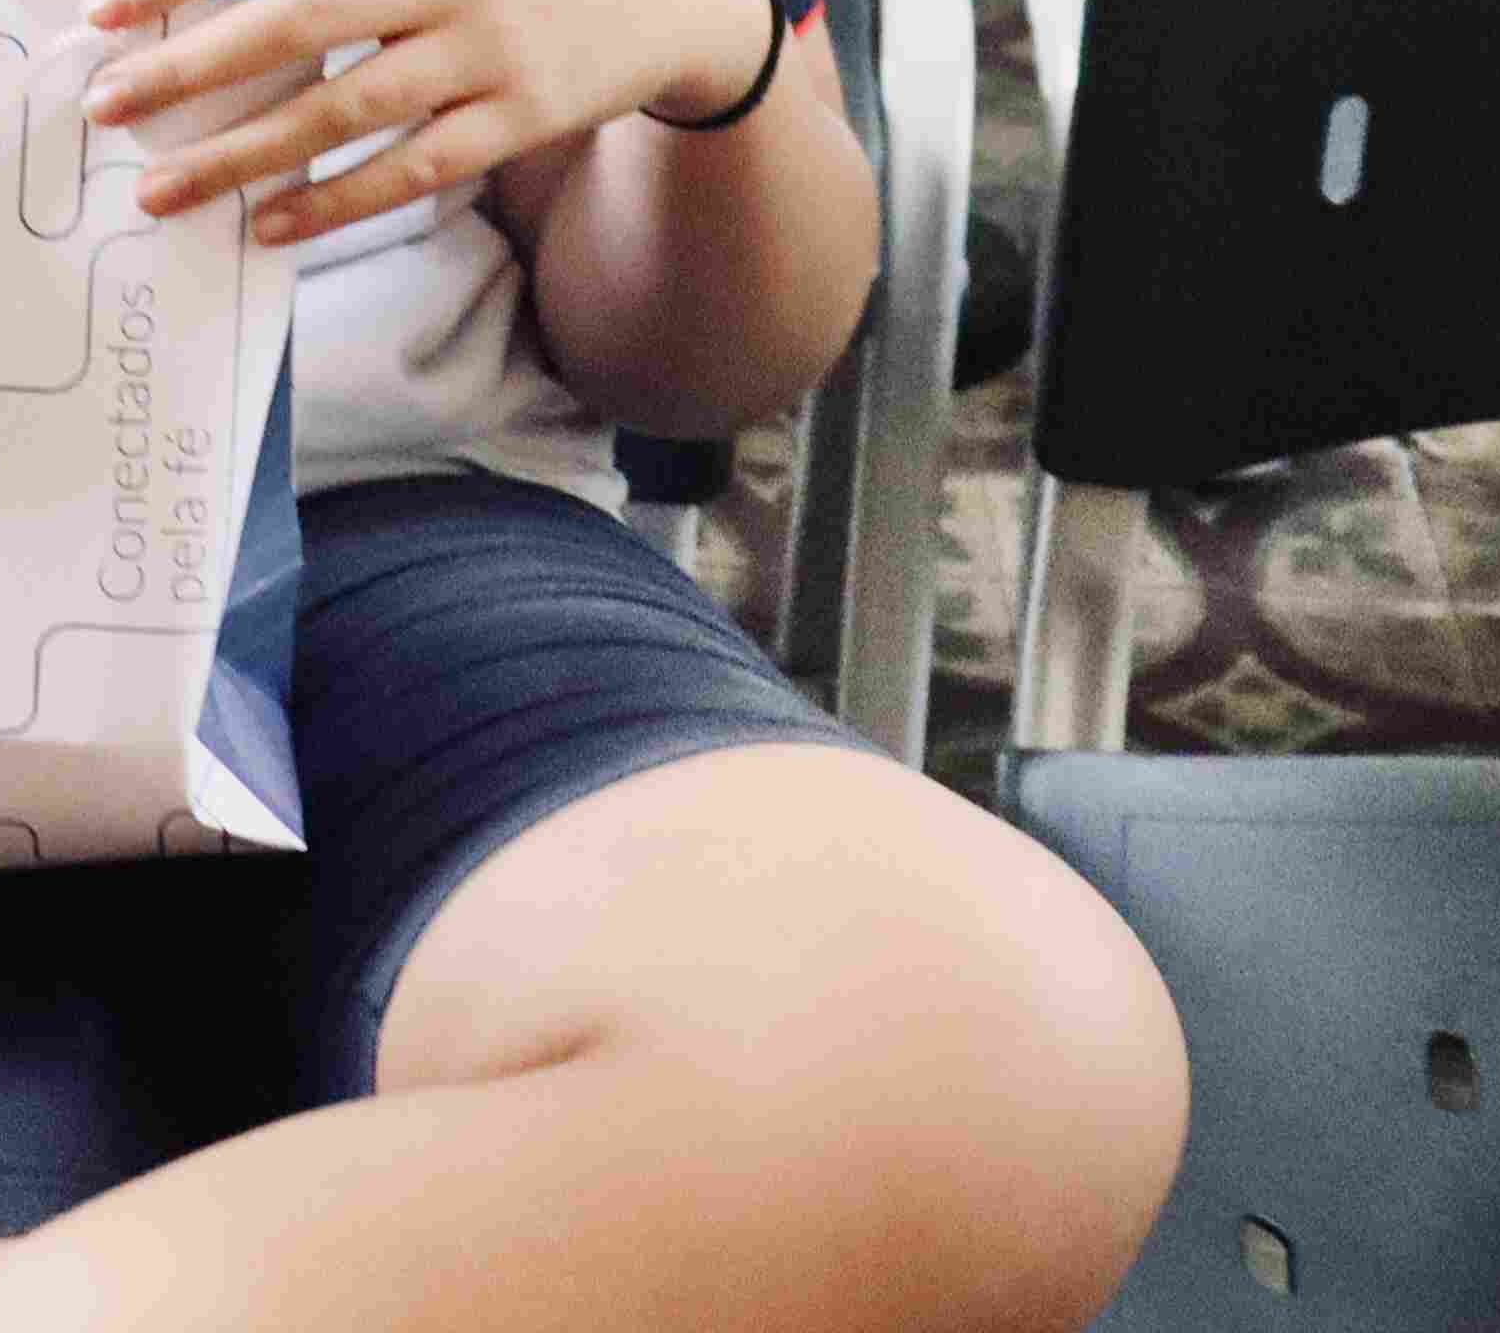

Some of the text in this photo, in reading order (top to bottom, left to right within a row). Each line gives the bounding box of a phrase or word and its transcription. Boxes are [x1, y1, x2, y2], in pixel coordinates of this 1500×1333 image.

[96, 282, 155, 602] Conectados
[160, 427, 212, 603] pela fé
